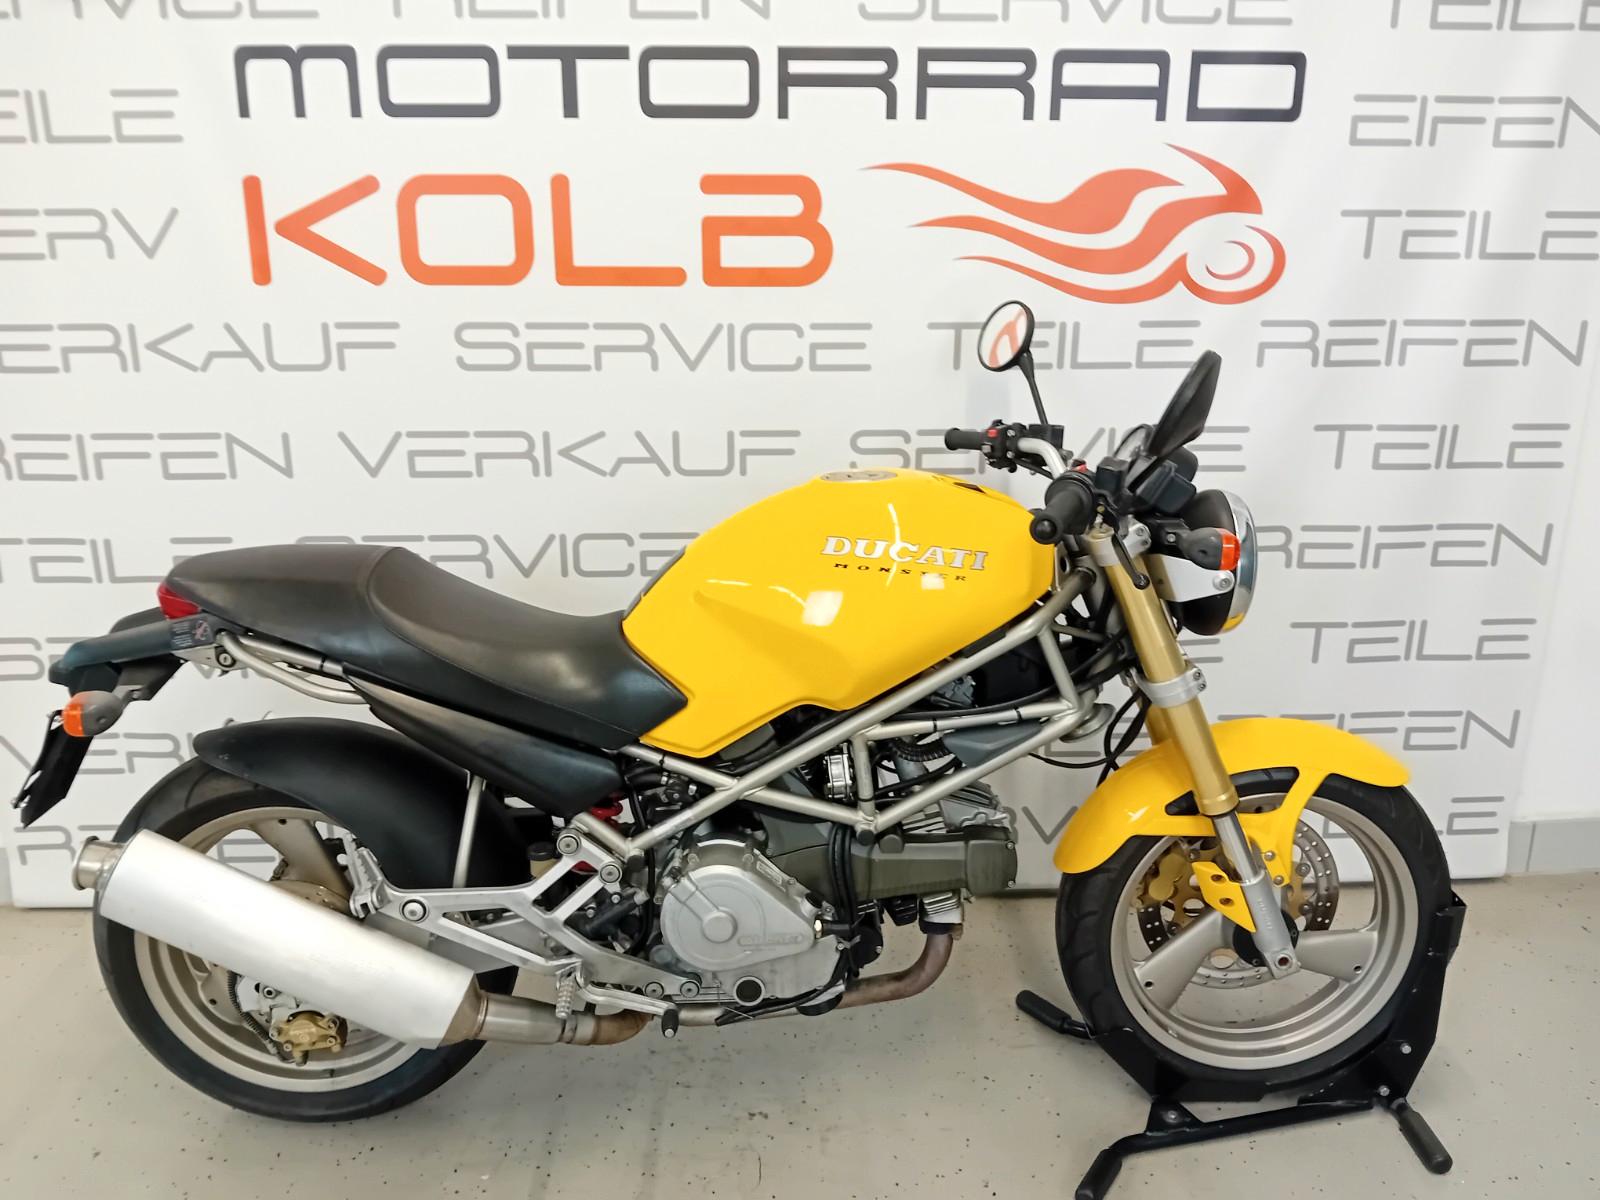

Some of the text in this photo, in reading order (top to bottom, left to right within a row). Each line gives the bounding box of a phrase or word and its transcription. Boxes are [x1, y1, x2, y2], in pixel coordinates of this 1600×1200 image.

[1390, 0, 1600, 31] EIL
[233, 44, 1307, 122] MOTORRAD
[1349, 94, 1600, 149] EIFEN
[242, 173, 833, 287] KOLB
[1340, 209, 1600, 260] TEILE
[0, 322, 400, 373] ERKAUF
[454, 322, 872, 372] SERVICE
[1256, 319, 1588, 368] REIFEN
[0, 432, 293, 481] EIFEN
[337, 430, 800, 480] VERKAUF
[1314, 423, 1570, 470] TEILE
[293, 532, 700, 579] RVICE
[820, 535, 989, 571] DUCATI
[1254, 523, 1554, 569] REIFEN
[1289, 618, 1537, 664] TEILE
[1217, 709, 1521, 751] FEN
